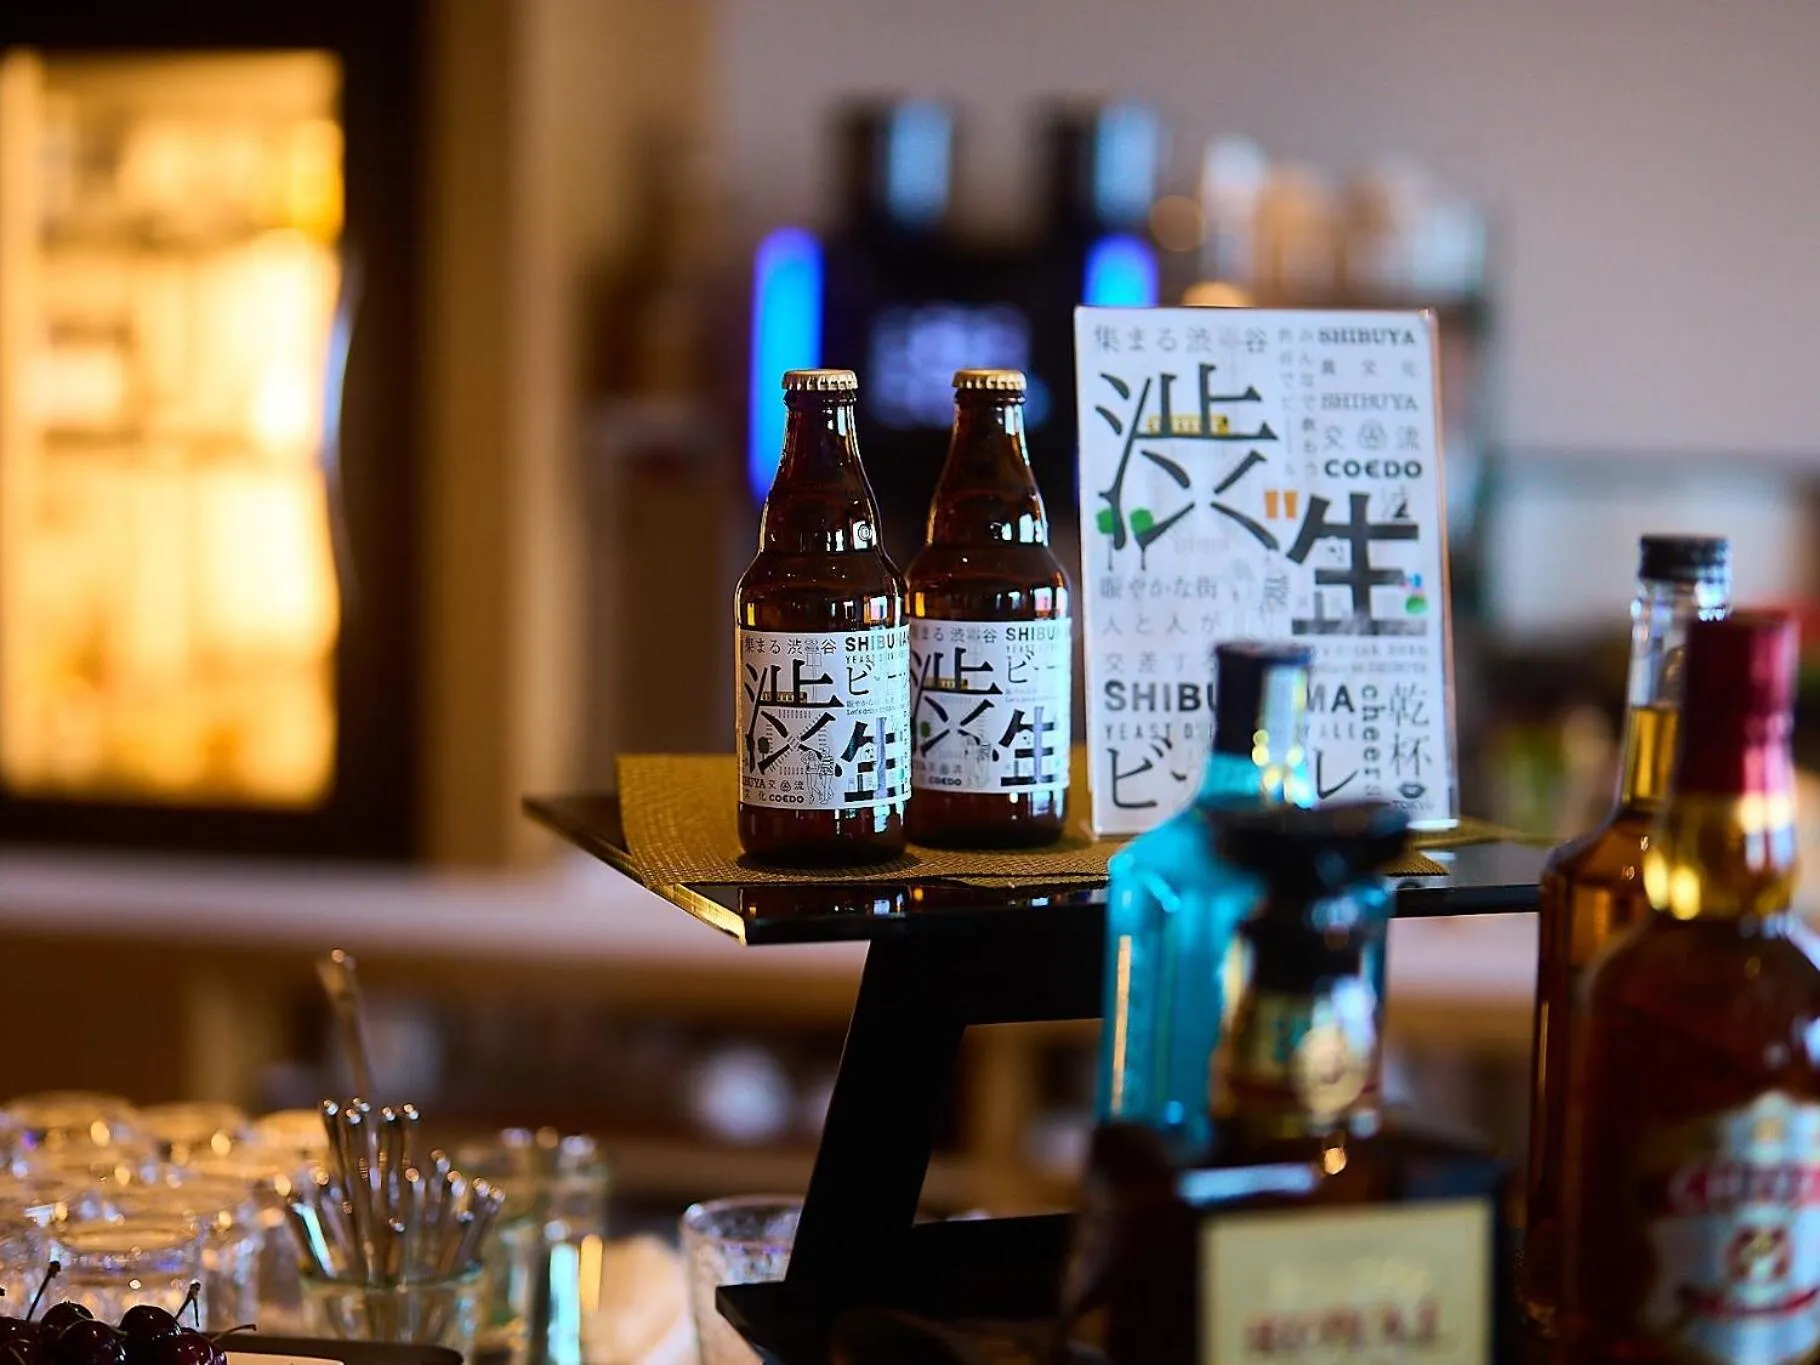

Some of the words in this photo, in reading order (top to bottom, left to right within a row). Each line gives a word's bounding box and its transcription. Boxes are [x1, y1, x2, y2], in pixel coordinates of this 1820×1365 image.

[1319, 327, 1416, 345] SHIBUYA
[1320, 393, 1419, 410] SHIBUYA
[1324, 458, 1423, 479] COEDO
[769, 794, 804, 803] COEDO
